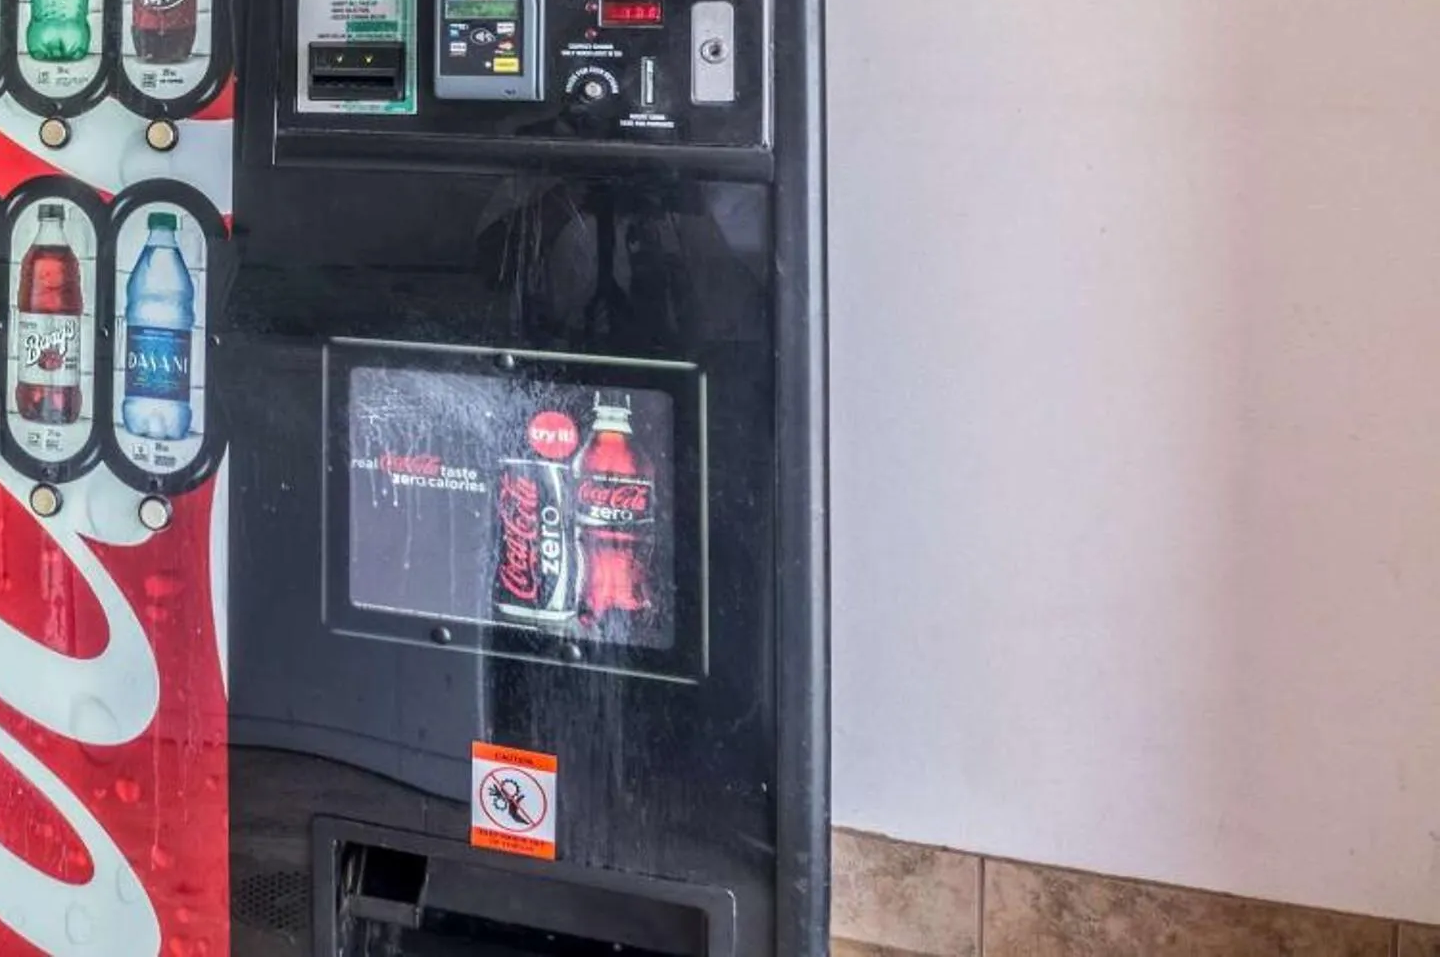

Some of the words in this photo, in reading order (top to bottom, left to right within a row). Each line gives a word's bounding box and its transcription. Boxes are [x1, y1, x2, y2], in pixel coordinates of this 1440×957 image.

[351, 457, 378, 469] real
[440, 465, 477, 480] taste
[392, 473, 426, 487] zero
[427, 478, 486, 493] calories
[591, 505, 633, 521] zero
[541, 505, 560, 575] zero
